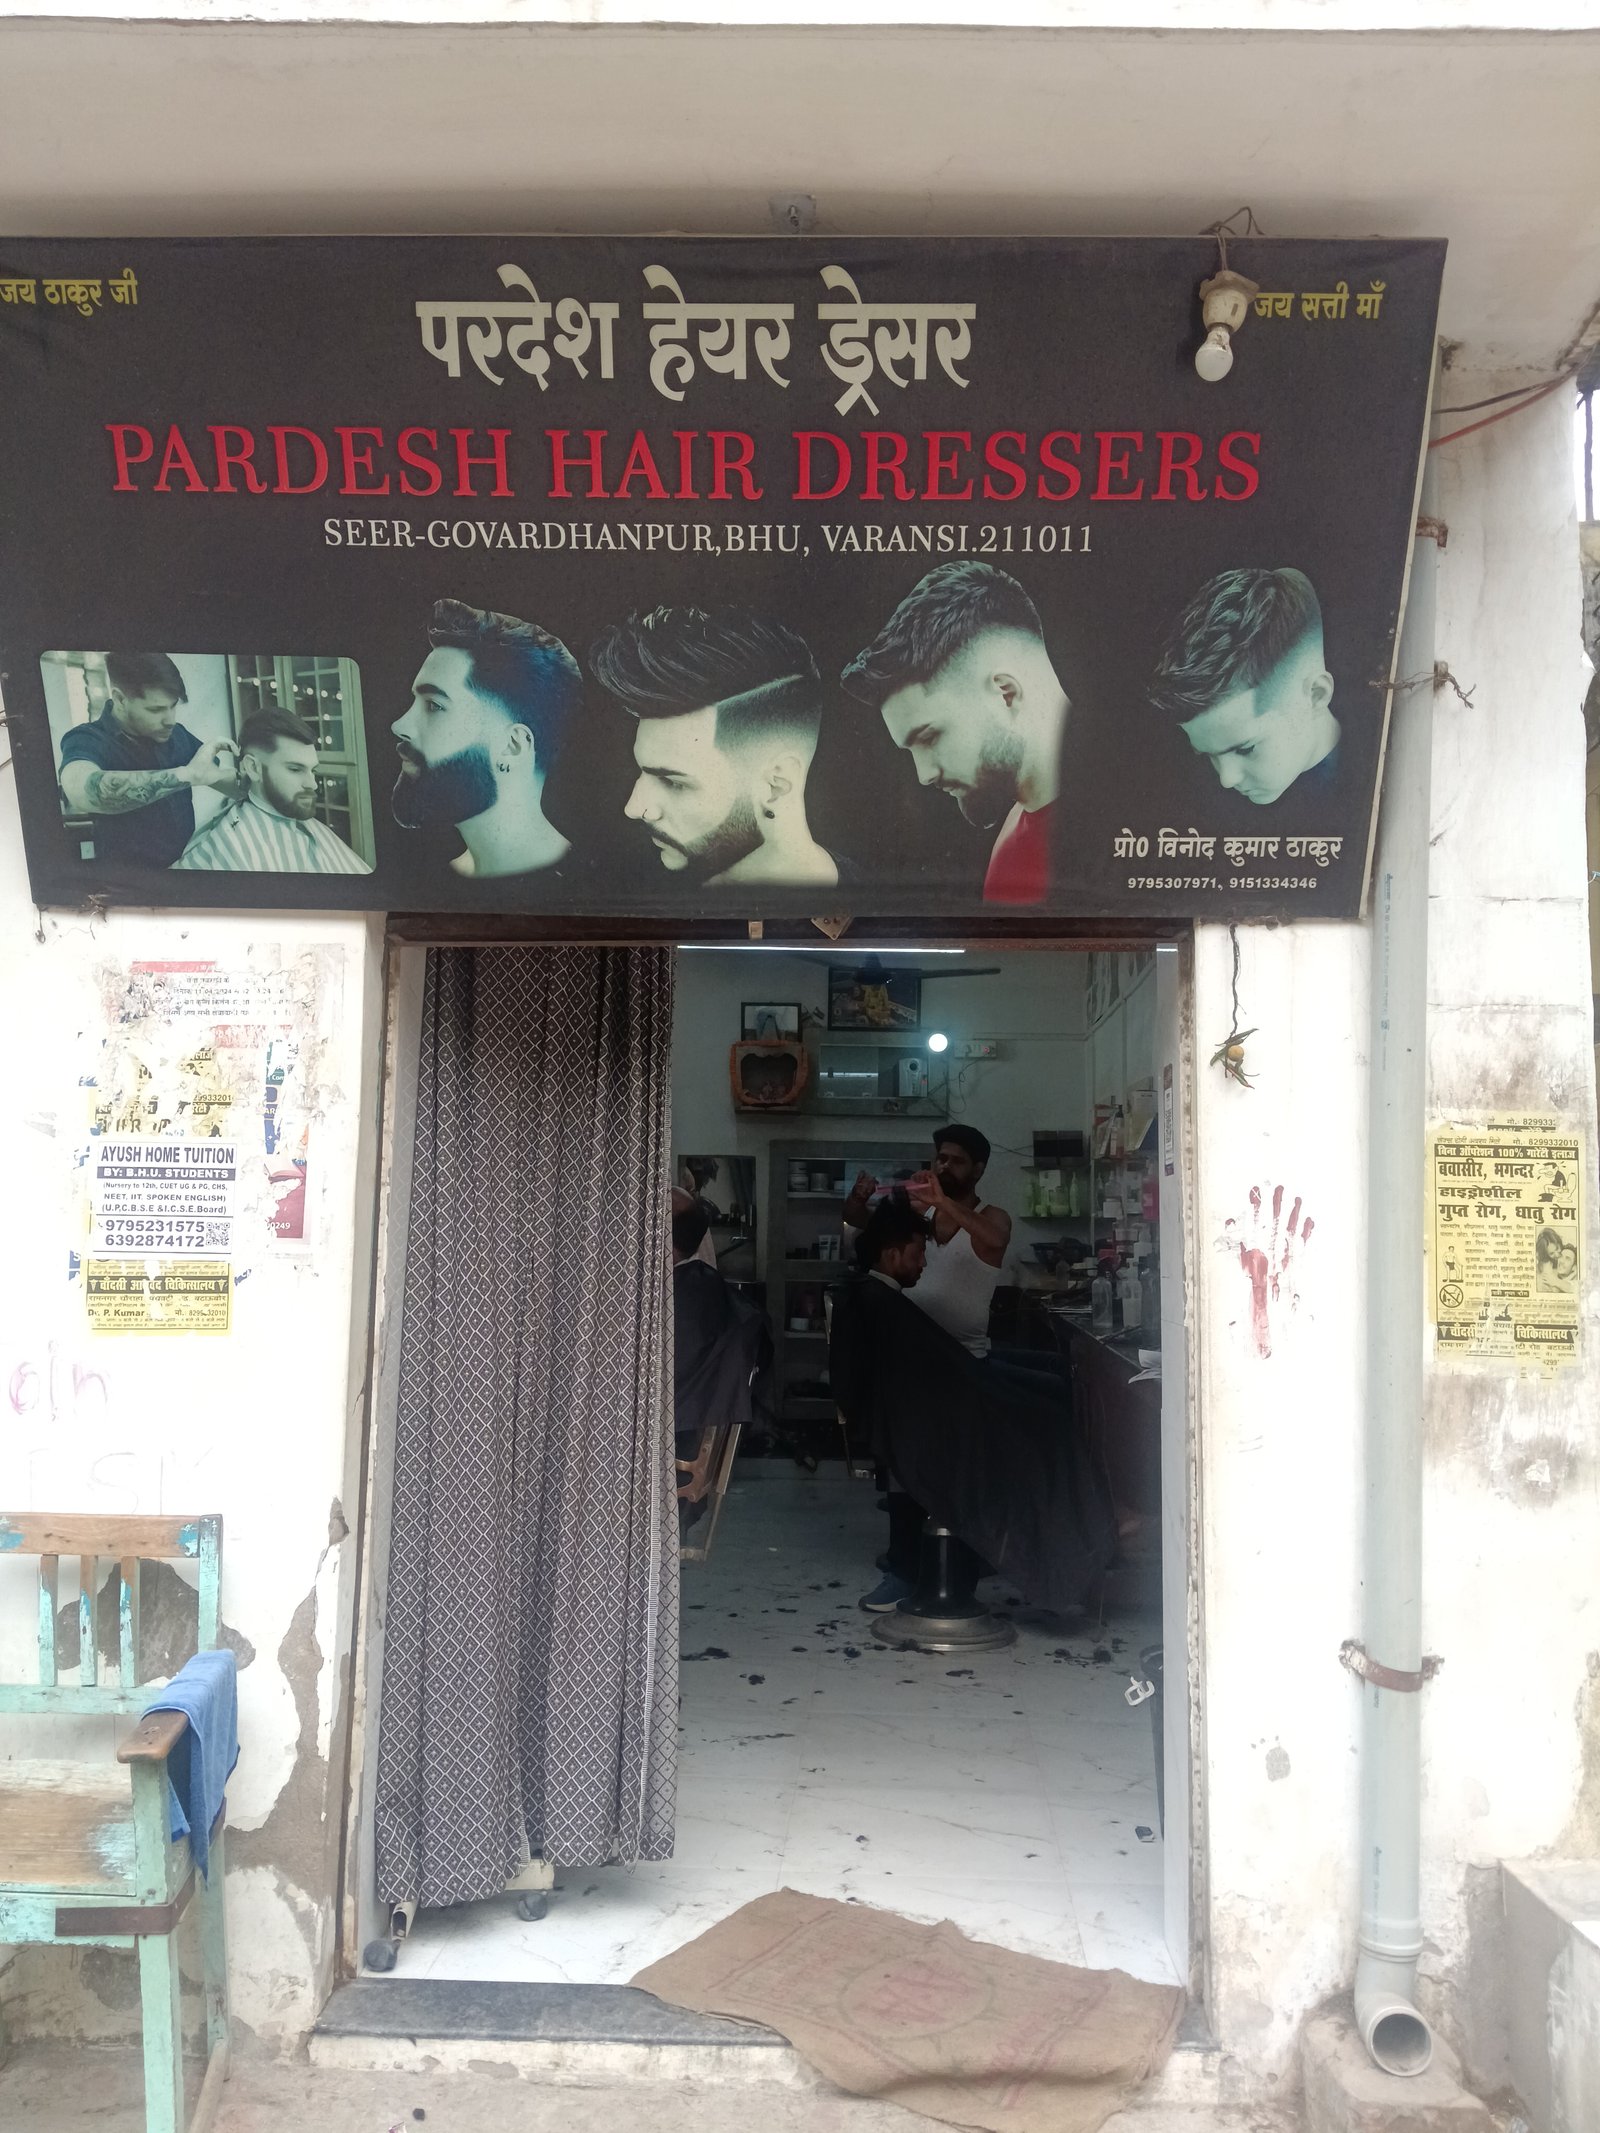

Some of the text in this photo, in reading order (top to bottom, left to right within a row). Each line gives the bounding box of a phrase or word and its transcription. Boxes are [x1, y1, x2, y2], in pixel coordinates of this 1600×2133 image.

[0, 267, 138, 317] जय ठाकुर जी
[1254, 292, 1295, 318] जय
[1356, 280, 1387, 319] माँ
[416, 263, 976, 416] परदेश हेयर ड्रेसर
[105, 424, 1262, 501] PARDESH HAIR DRESSERS
[821, 524, 1092, 554] VARANSI.211011
[1157, 827, 1217, 861] विनोद
[1223, 836, 1281, 867] कुमार
[1286, 836, 1344, 867] ठाकुर
[1128, 877, 1317, 891] 9795307971, 9151334346
[1438, 1145, 1457, 1156] बिना
[1498, 1148, 1523, 1158] 100%
[1528, 1138, 1579, 1147] 8299332010
[101, 1146, 234, 1164] AYUSH HOME TUITION
[103, 1168, 229, 1178] BY: B.H.U. STUDENTS
[185, 1194, 226, 1202] ENGLISH)
[1438, 1202, 1577, 1224] गुप्त रोग, धातु रोग
[105, 1220, 205, 1233] 9795231575
[105, 1234, 205, 1247] 6392874172
